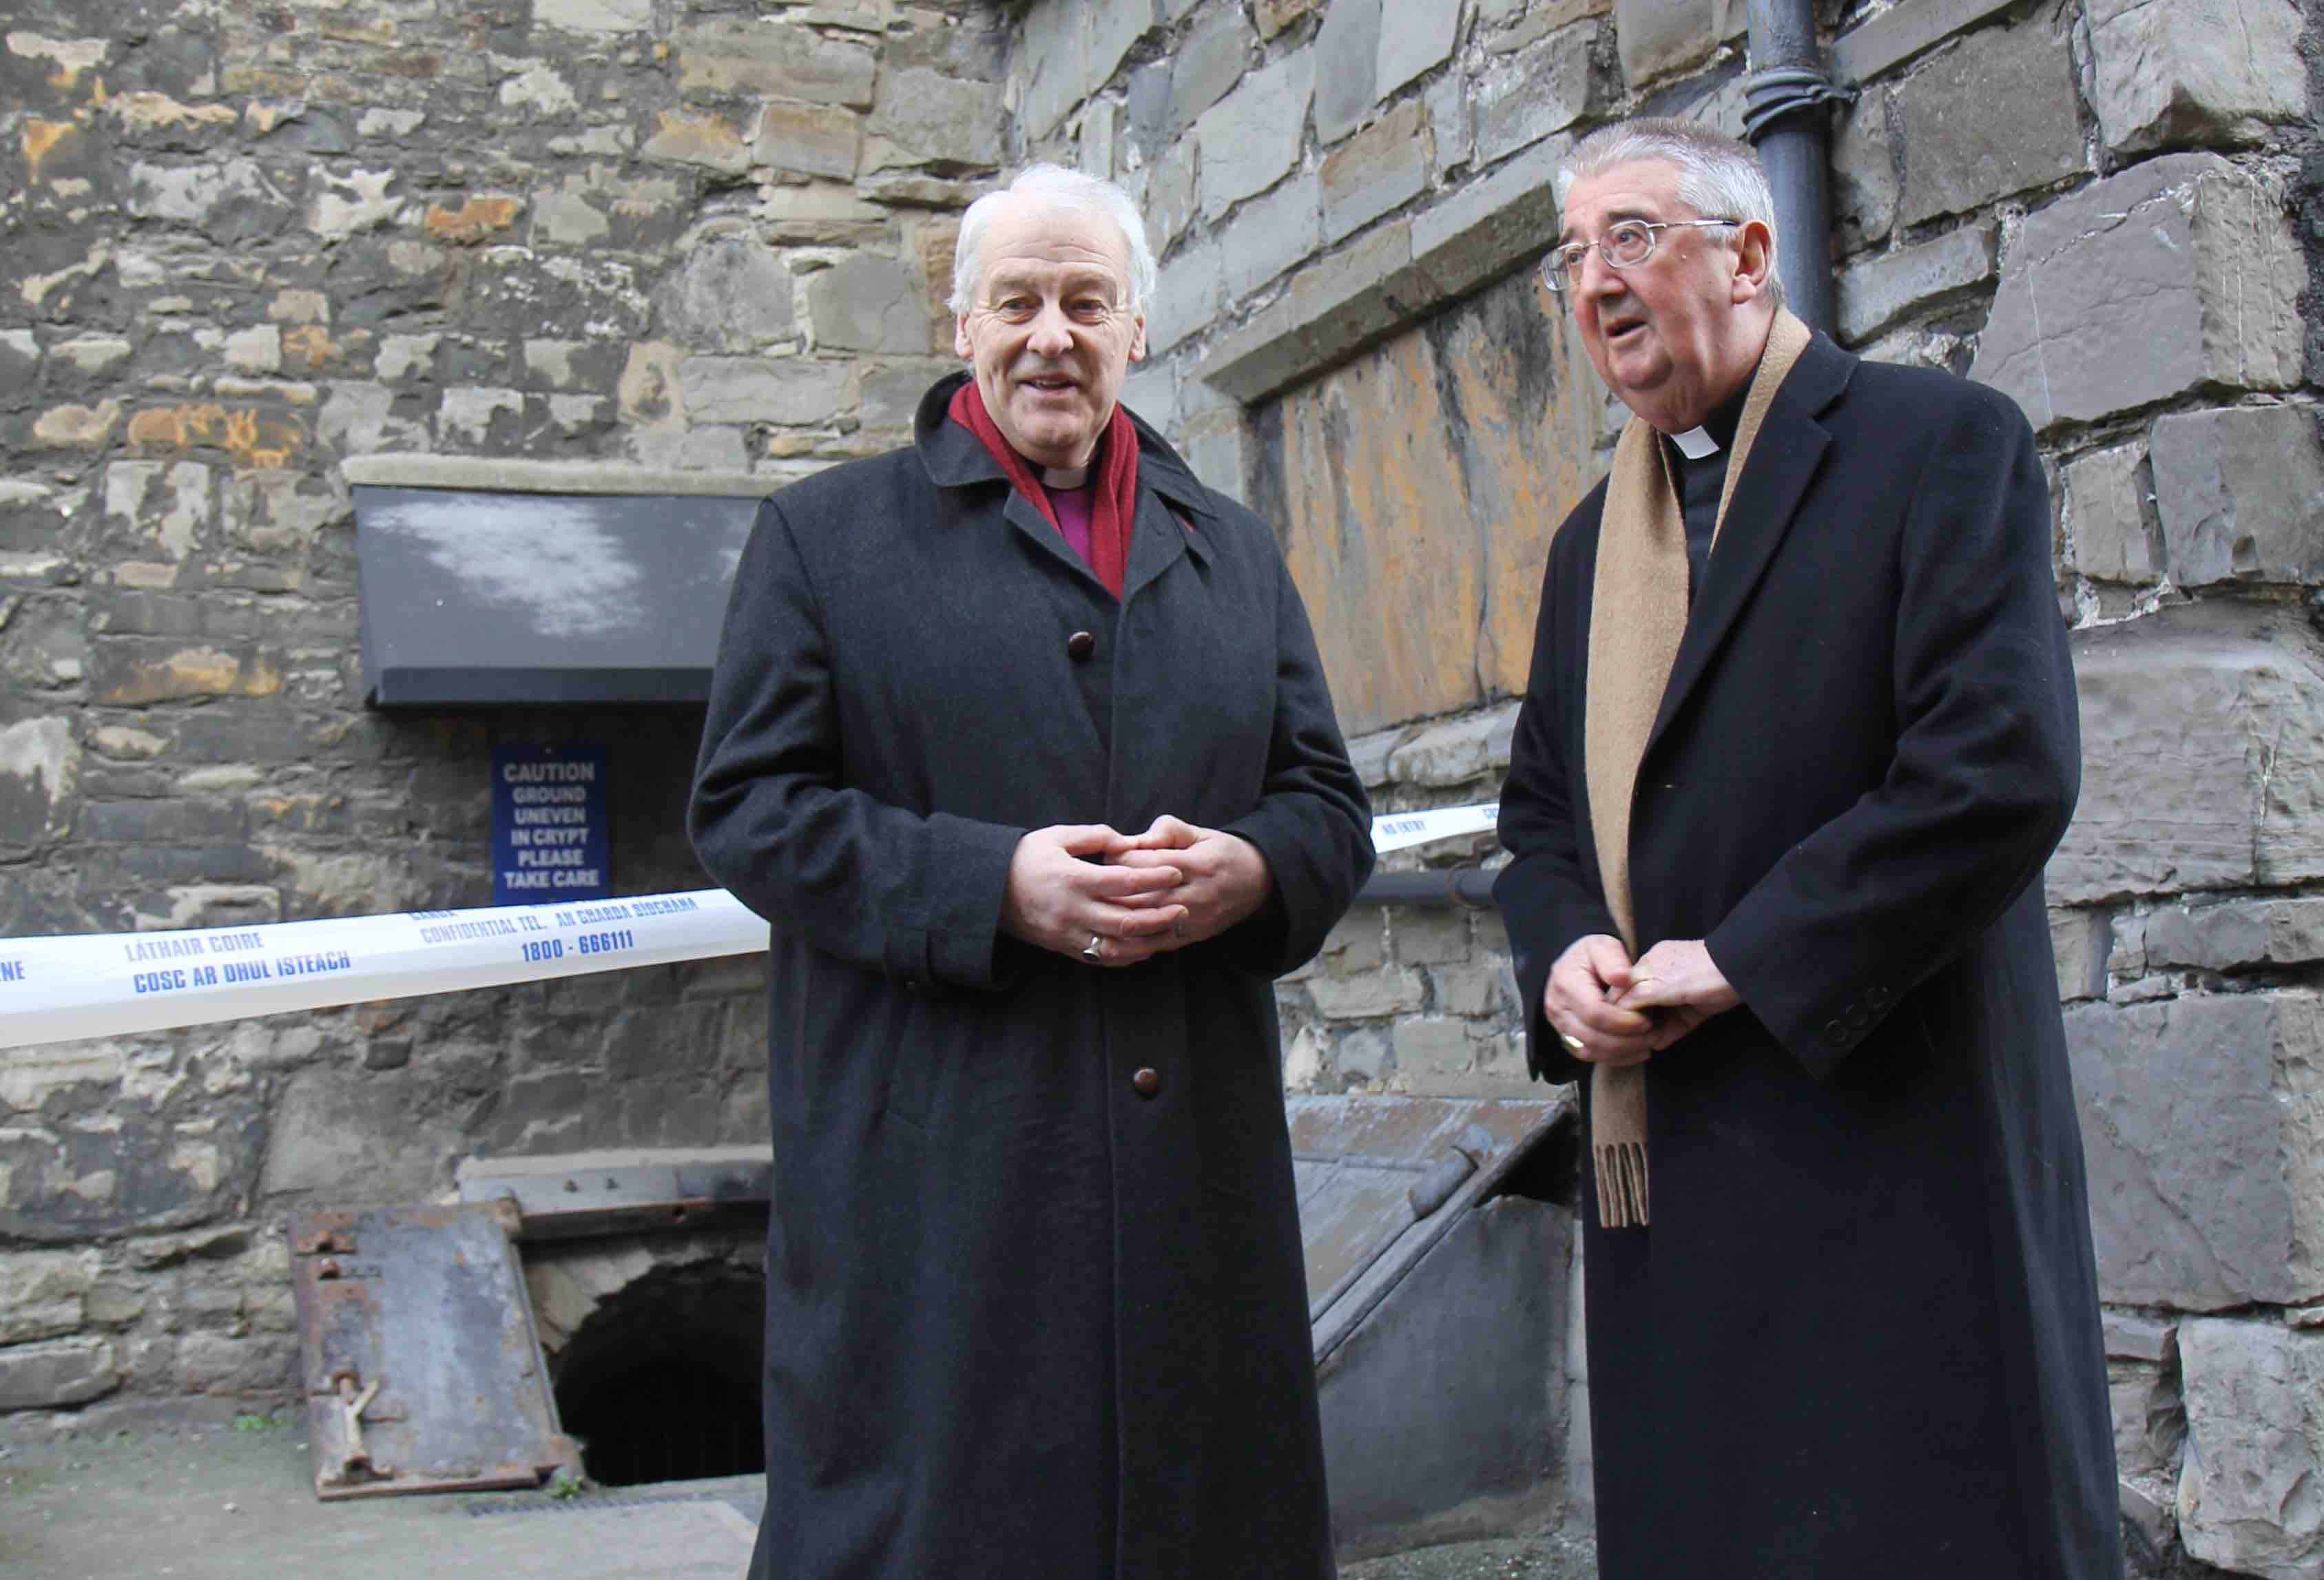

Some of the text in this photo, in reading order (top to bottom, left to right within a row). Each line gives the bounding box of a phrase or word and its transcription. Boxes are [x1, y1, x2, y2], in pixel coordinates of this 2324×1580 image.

[504, 761, 595, 782] CAUTION
[512, 786, 586, 804] GROUND
[514, 807, 585, 824] UNEVEN
[510, 827, 590, 846] IN CRYPT
[518, 849, 584, 867] PLEASE
[504, 869, 600, 889] TAKE CARE
[419, 915, 548, 944] CONFIDENTIAL TEL.
[555, 911, 576, 928] AN
[124, 932, 265, 963] LÁTHAIR COIRE
[521, 938, 563, 962] 1800
[578, 929, 634, 955] 666111
[133, 950, 351, 993] COSC AR DHUL ISTEACH
